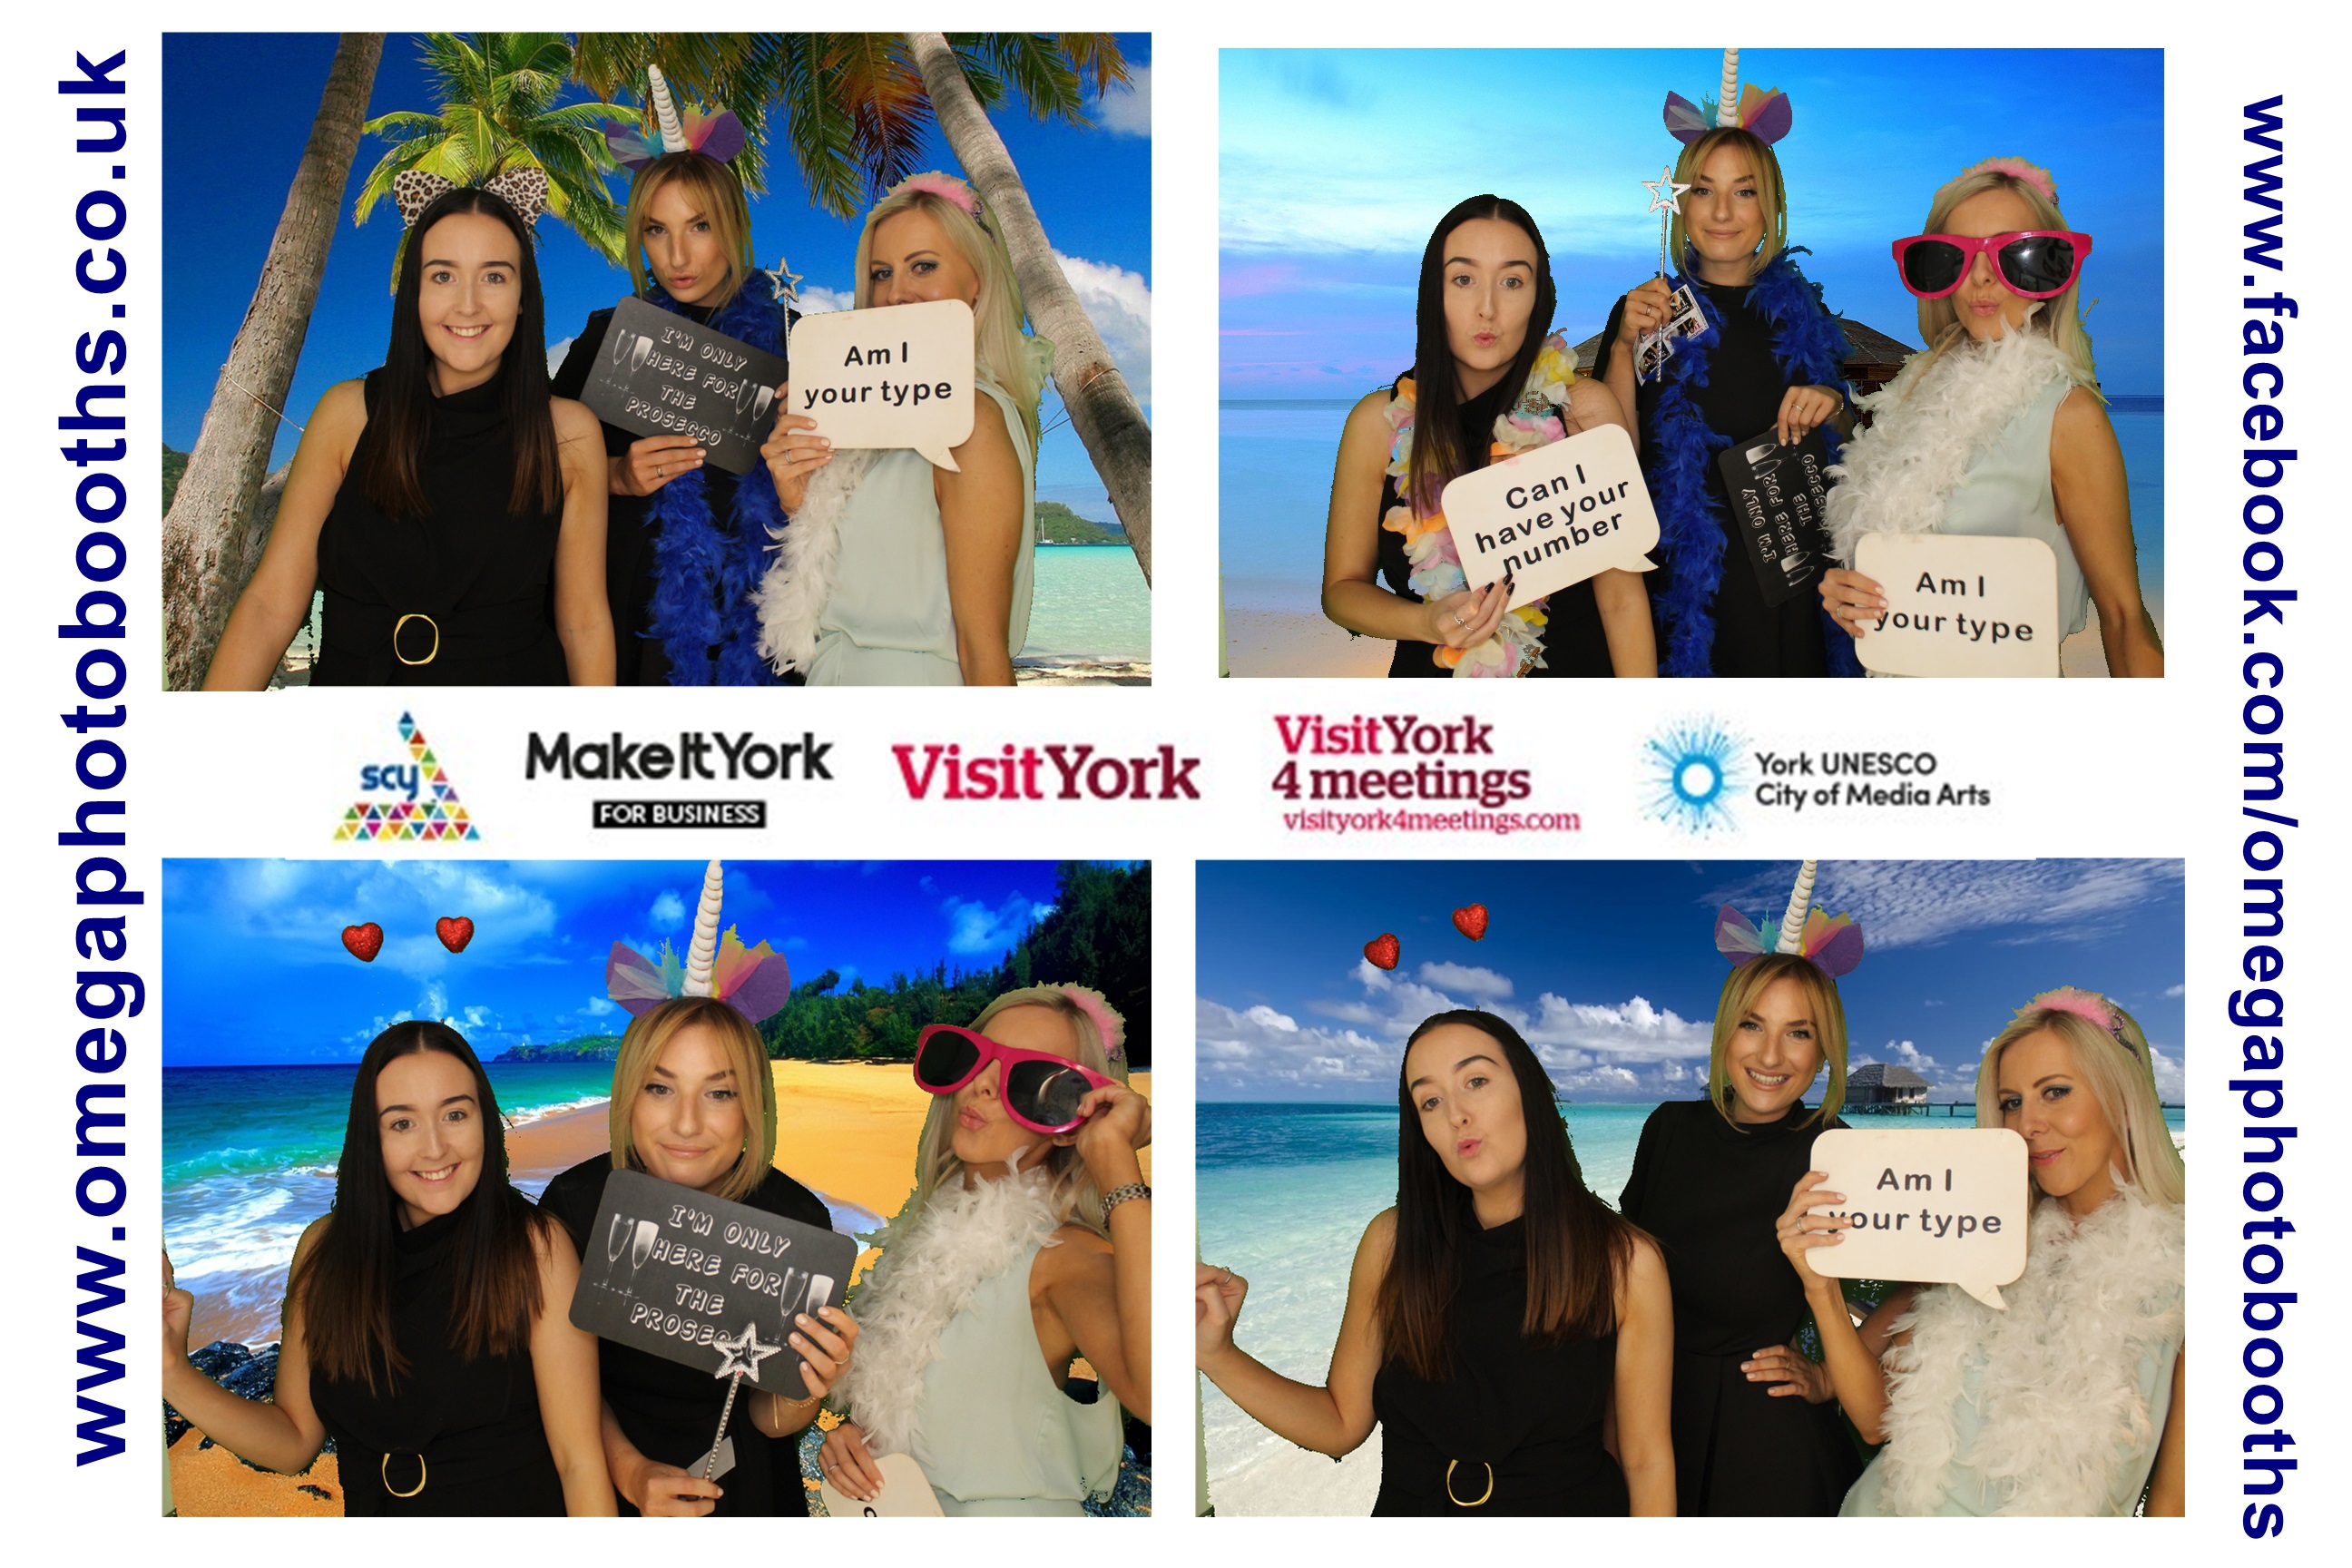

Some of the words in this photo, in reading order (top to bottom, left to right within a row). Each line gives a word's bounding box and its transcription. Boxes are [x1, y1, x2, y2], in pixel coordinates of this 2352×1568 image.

[661, 326, 694, 352] I'M
[701, 342, 748, 372] ONLY
[844, 345, 891, 367] Am
[901, 341, 908, 364] I
[646, 349, 698, 381] HERE
[702, 373, 739, 399] FOR
[661, 385, 697, 410] THE
[804, 385, 872, 409] your
[881, 379, 953, 407] type
[625, 396, 722, 446] PROSECCO
[1505, 475, 1569, 509] Can
[1575, 464, 1586, 485] I
[1762, 473, 1784, 507] FOR
[1801, 454, 1834, 538] OSECCO
[1475, 512, 1553, 554] have
[1560, 481, 1629, 526] your
[1741, 489, 1766, 528] ONLY
[1792, 493, 1813, 527] THE
[1503, 513, 1622, 573] number
[1774, 511, 1799, 556] HERE
[1916, 572, 1965, 595] Am
[1978, 575, 1985, 597] I
[1874, 612, 1947, 632] your
[1956, 612, 2033, 643] type
[1876, 1168, 1932, 1191] Am
[1945, 1168, 1952, 1191] I
[668, 1204, 714, 1237] I'M
[723, 1221, 791, 1259] ONLY
[1919, 1209, 2002, 1240] type
[651, 1238, 722, 1276] HERE
[730, 1262, 782, 1298] FOR
[675, 1283, 725, 1316] THE
